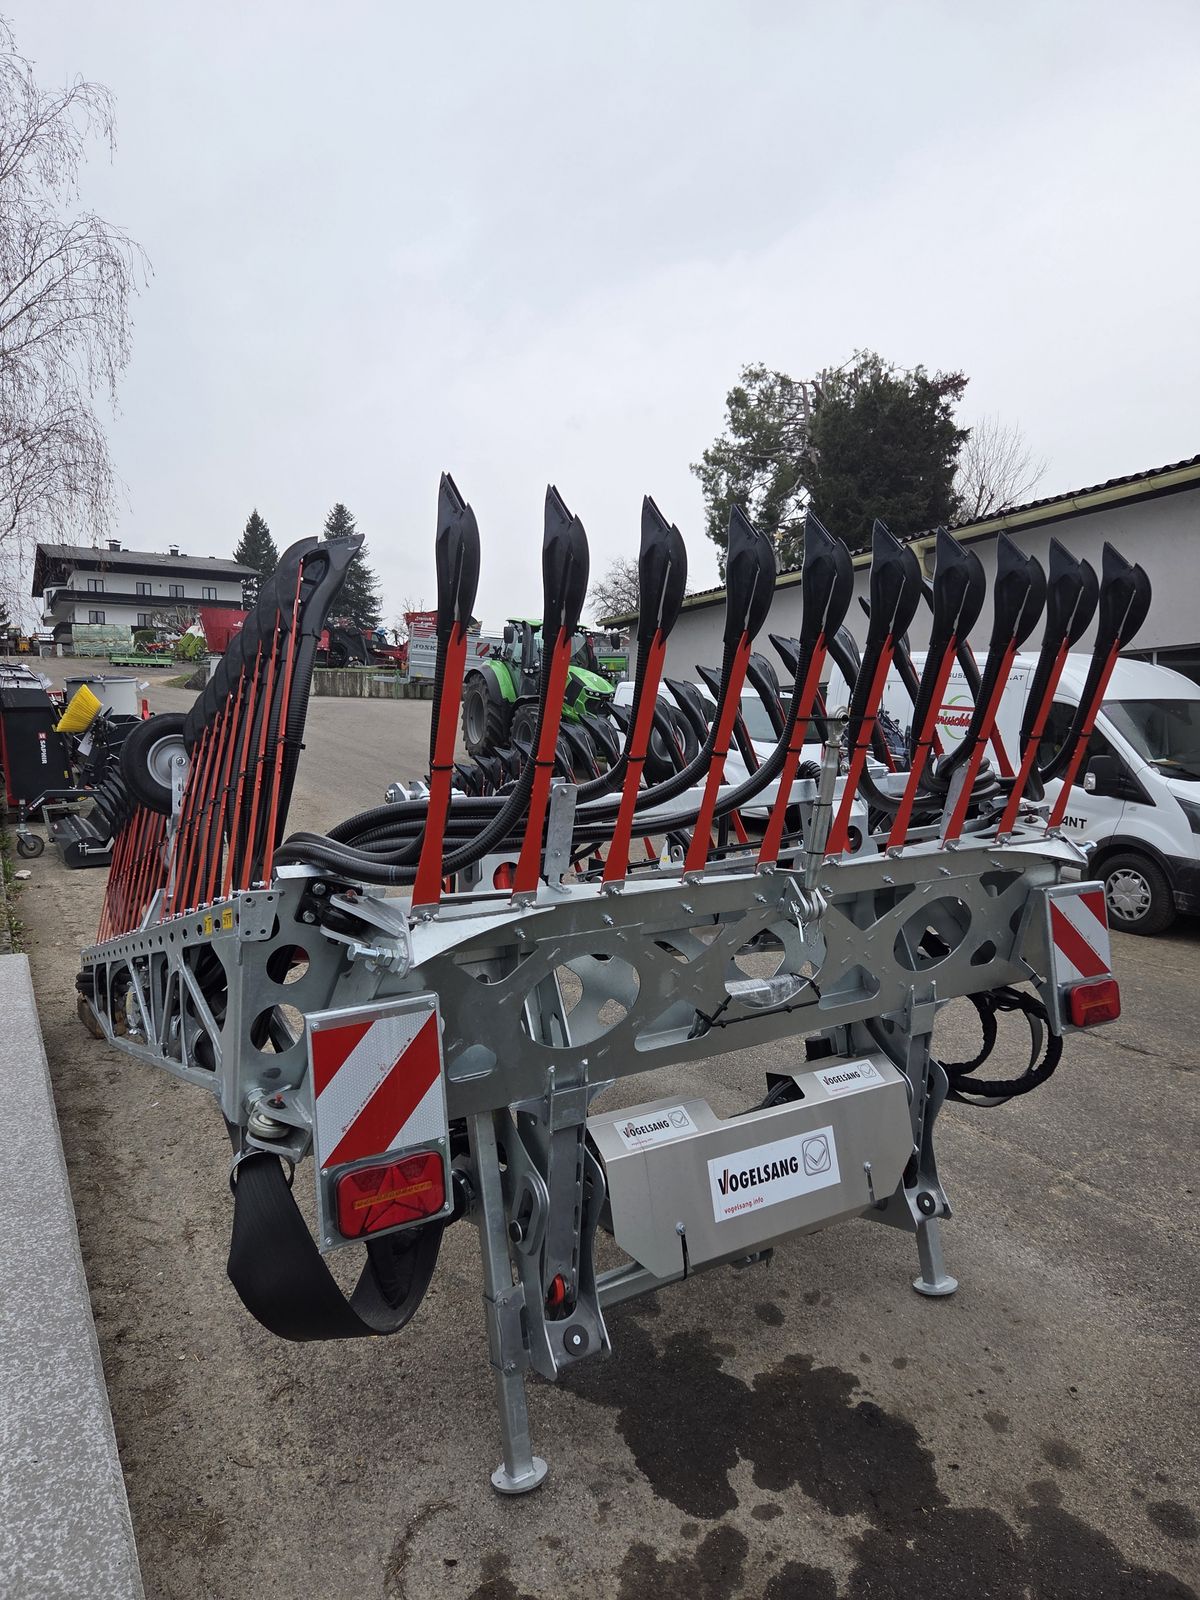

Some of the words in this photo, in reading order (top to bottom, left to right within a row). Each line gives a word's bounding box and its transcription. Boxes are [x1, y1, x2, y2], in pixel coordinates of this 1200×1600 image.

[822, 1071, 861, 1086] VOGELSANG
[622, 1119, 670, 1138] VOGELSANG
[717, 1156, 800, 1196] VOGELSANG
